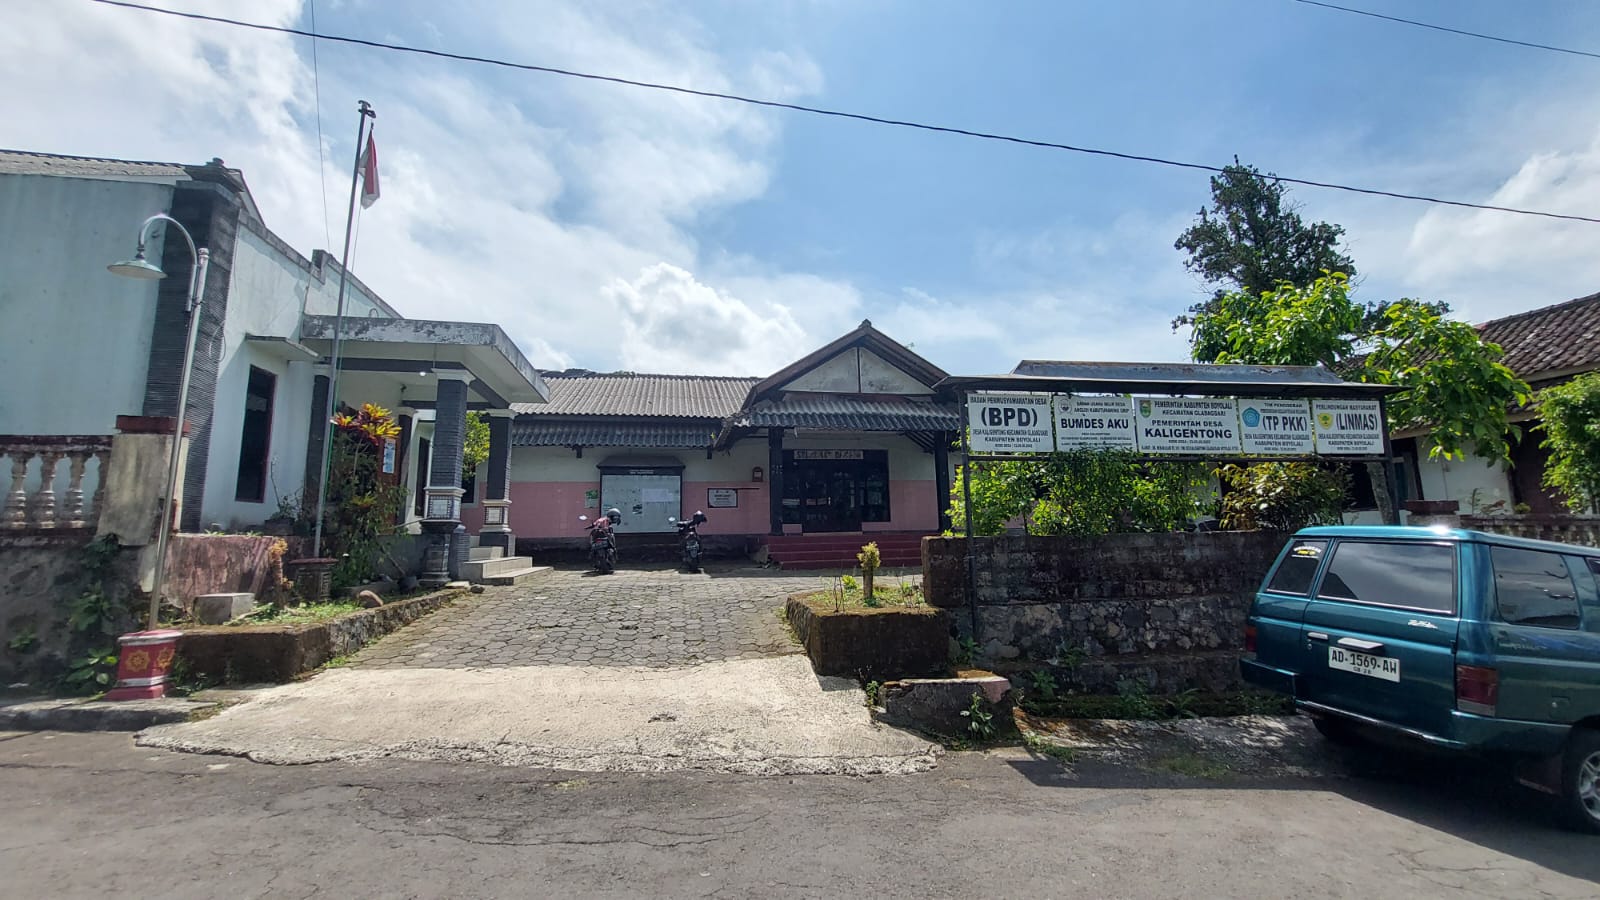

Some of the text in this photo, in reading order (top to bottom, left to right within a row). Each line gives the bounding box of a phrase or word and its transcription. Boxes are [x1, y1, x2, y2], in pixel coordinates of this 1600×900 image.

[1184, 401, 1210, 409] KABUPATEN
[981, 406, 1038, 427] (BPD)
[1336, 414, 1378, 430] (LINMAS)
[1060, 418, 1128, 428] BUMDES AKU
[1262, 416, 1308, 431] (TP PKK)
[1145, 428, 1232, 438] KALIGENTONG
